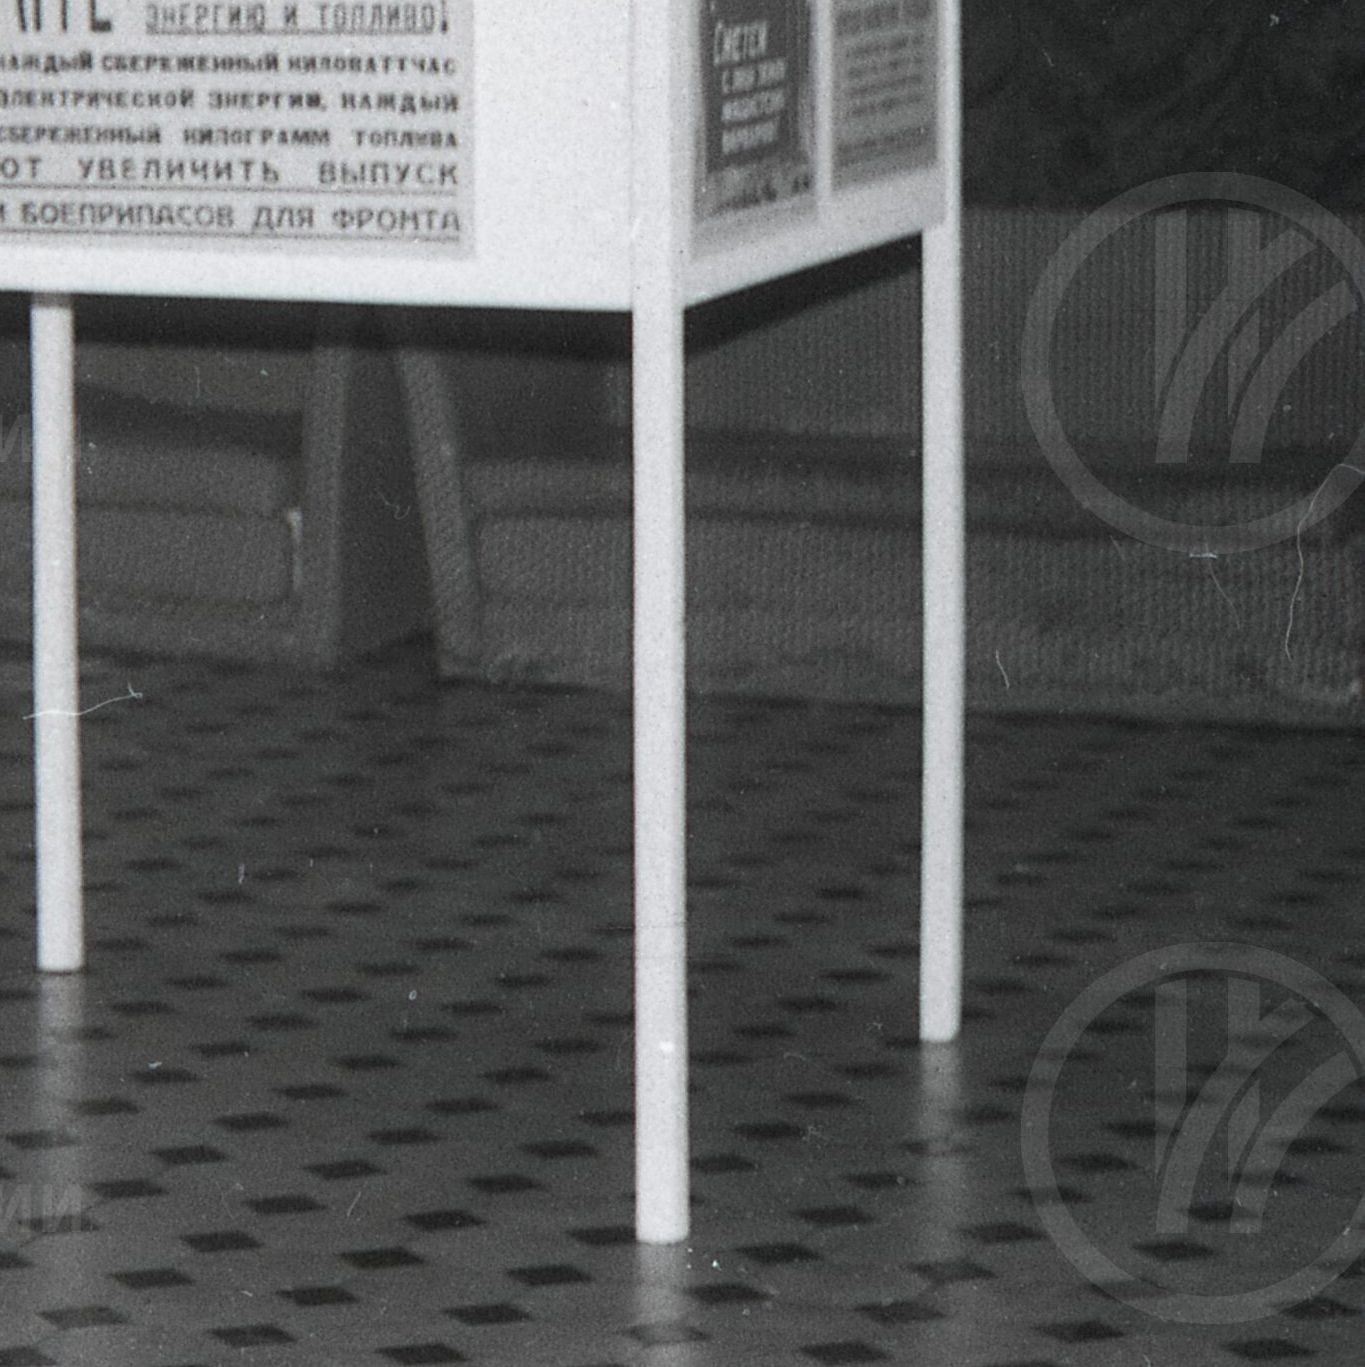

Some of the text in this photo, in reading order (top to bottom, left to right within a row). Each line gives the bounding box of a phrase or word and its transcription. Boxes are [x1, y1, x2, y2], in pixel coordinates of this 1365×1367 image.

[145, 2, 434, 33] ЭНЕРГИЮ И ТОПЛИВО
[101, 52, 279, 74] СБЕРЕЖЕННЫЙ
[287, 55, 457, 77] КИЛОВАТТЧАС
[341, 91, 460, 114] КАЖДЫЙ
[184, 126, 330, 148] КИЛОГРАММ
[354, 128, 458, 149] ТОПЛИВА
[77, 157, 280, 183] УВЕЛИЧИТЬ
[317, 161, 459, 186] ВЫПУСК
[21, 201, 234, 228] БОЕПРИПАСОВ
[252, 205, 313, 231] ДЛЯ
[332, 206, 460, 232] ФРОНТА
